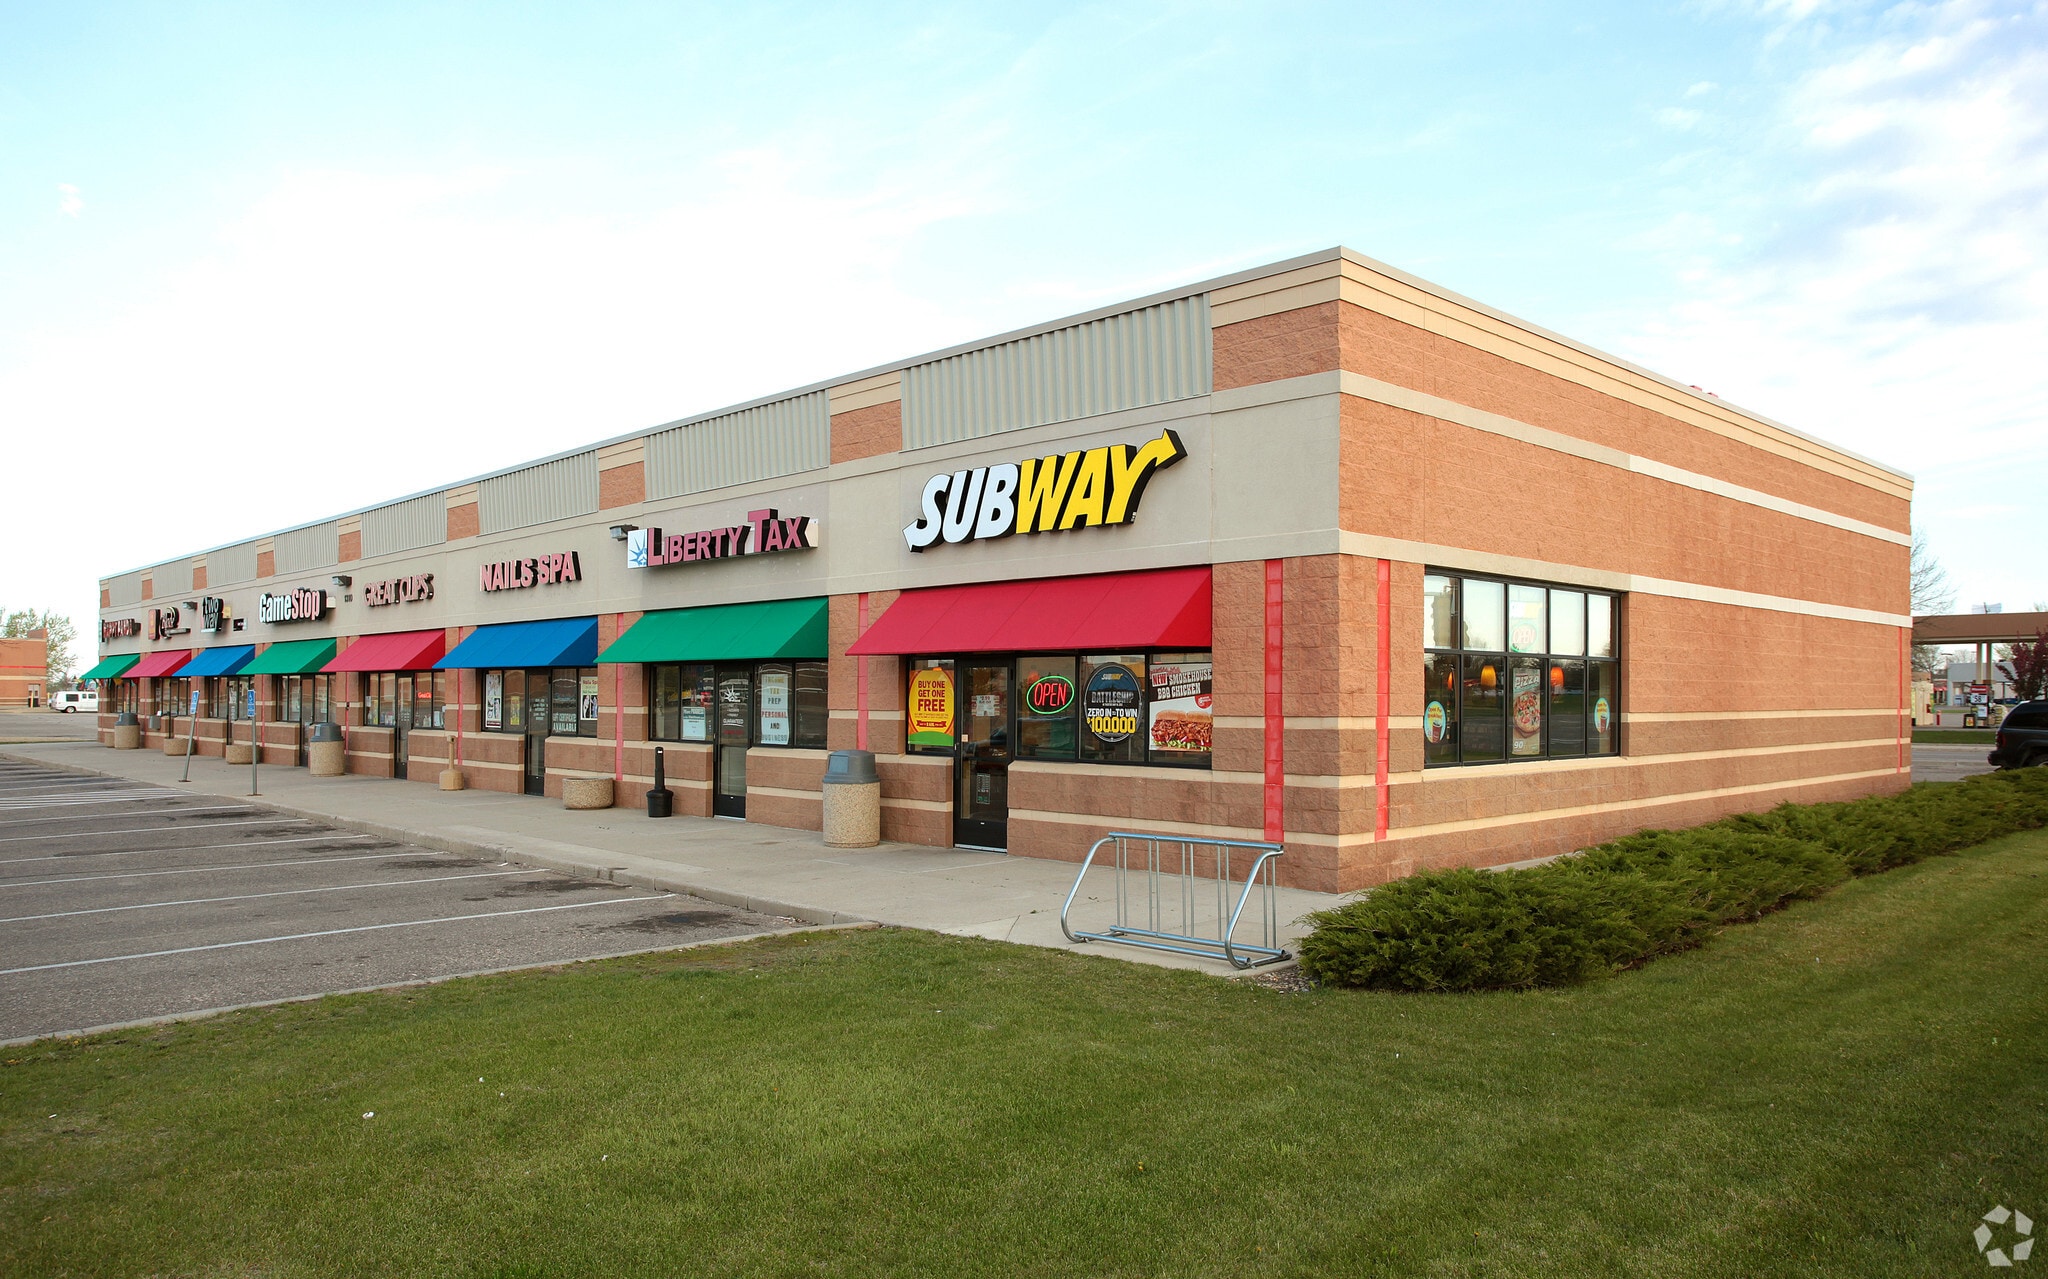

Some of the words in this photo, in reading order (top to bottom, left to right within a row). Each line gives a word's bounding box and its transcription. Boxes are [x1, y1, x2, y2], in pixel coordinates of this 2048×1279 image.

[903, 429, 1186, 553] SUBWAY
[647, 525, 749, 567] LIBERTY
[748, 508, 807, 553] TAX
[480, 557, 535, 592] NAILS
[538, 551, 580, 584] SPA
[364, 579, 397, 607] GREAT
[399, 573, 433, 601] CLIPS
[202, 596, 219, 614] two
[259, 588, 321, 624] GameStop
[1153, 674, 1166, 684] NEW
[1169, 669, 1212, 686] SMOKEHOUSE
[1514, 675, 1539, 688] PIZZA
[1034, 682, 1067, 707] OPEN
[1091, 691, 1134, 703] BATTLESHIP
[1171, 682, 1200, 698] CHICKEN
[918, 699, 945, 712] FREE
[1088, 708, 1104, 716] ZERO
[1105, 708, 1111, 717] IN
[1116, 708, 1124, 717] TO
[1125, 709, 1137, 717] WIN
